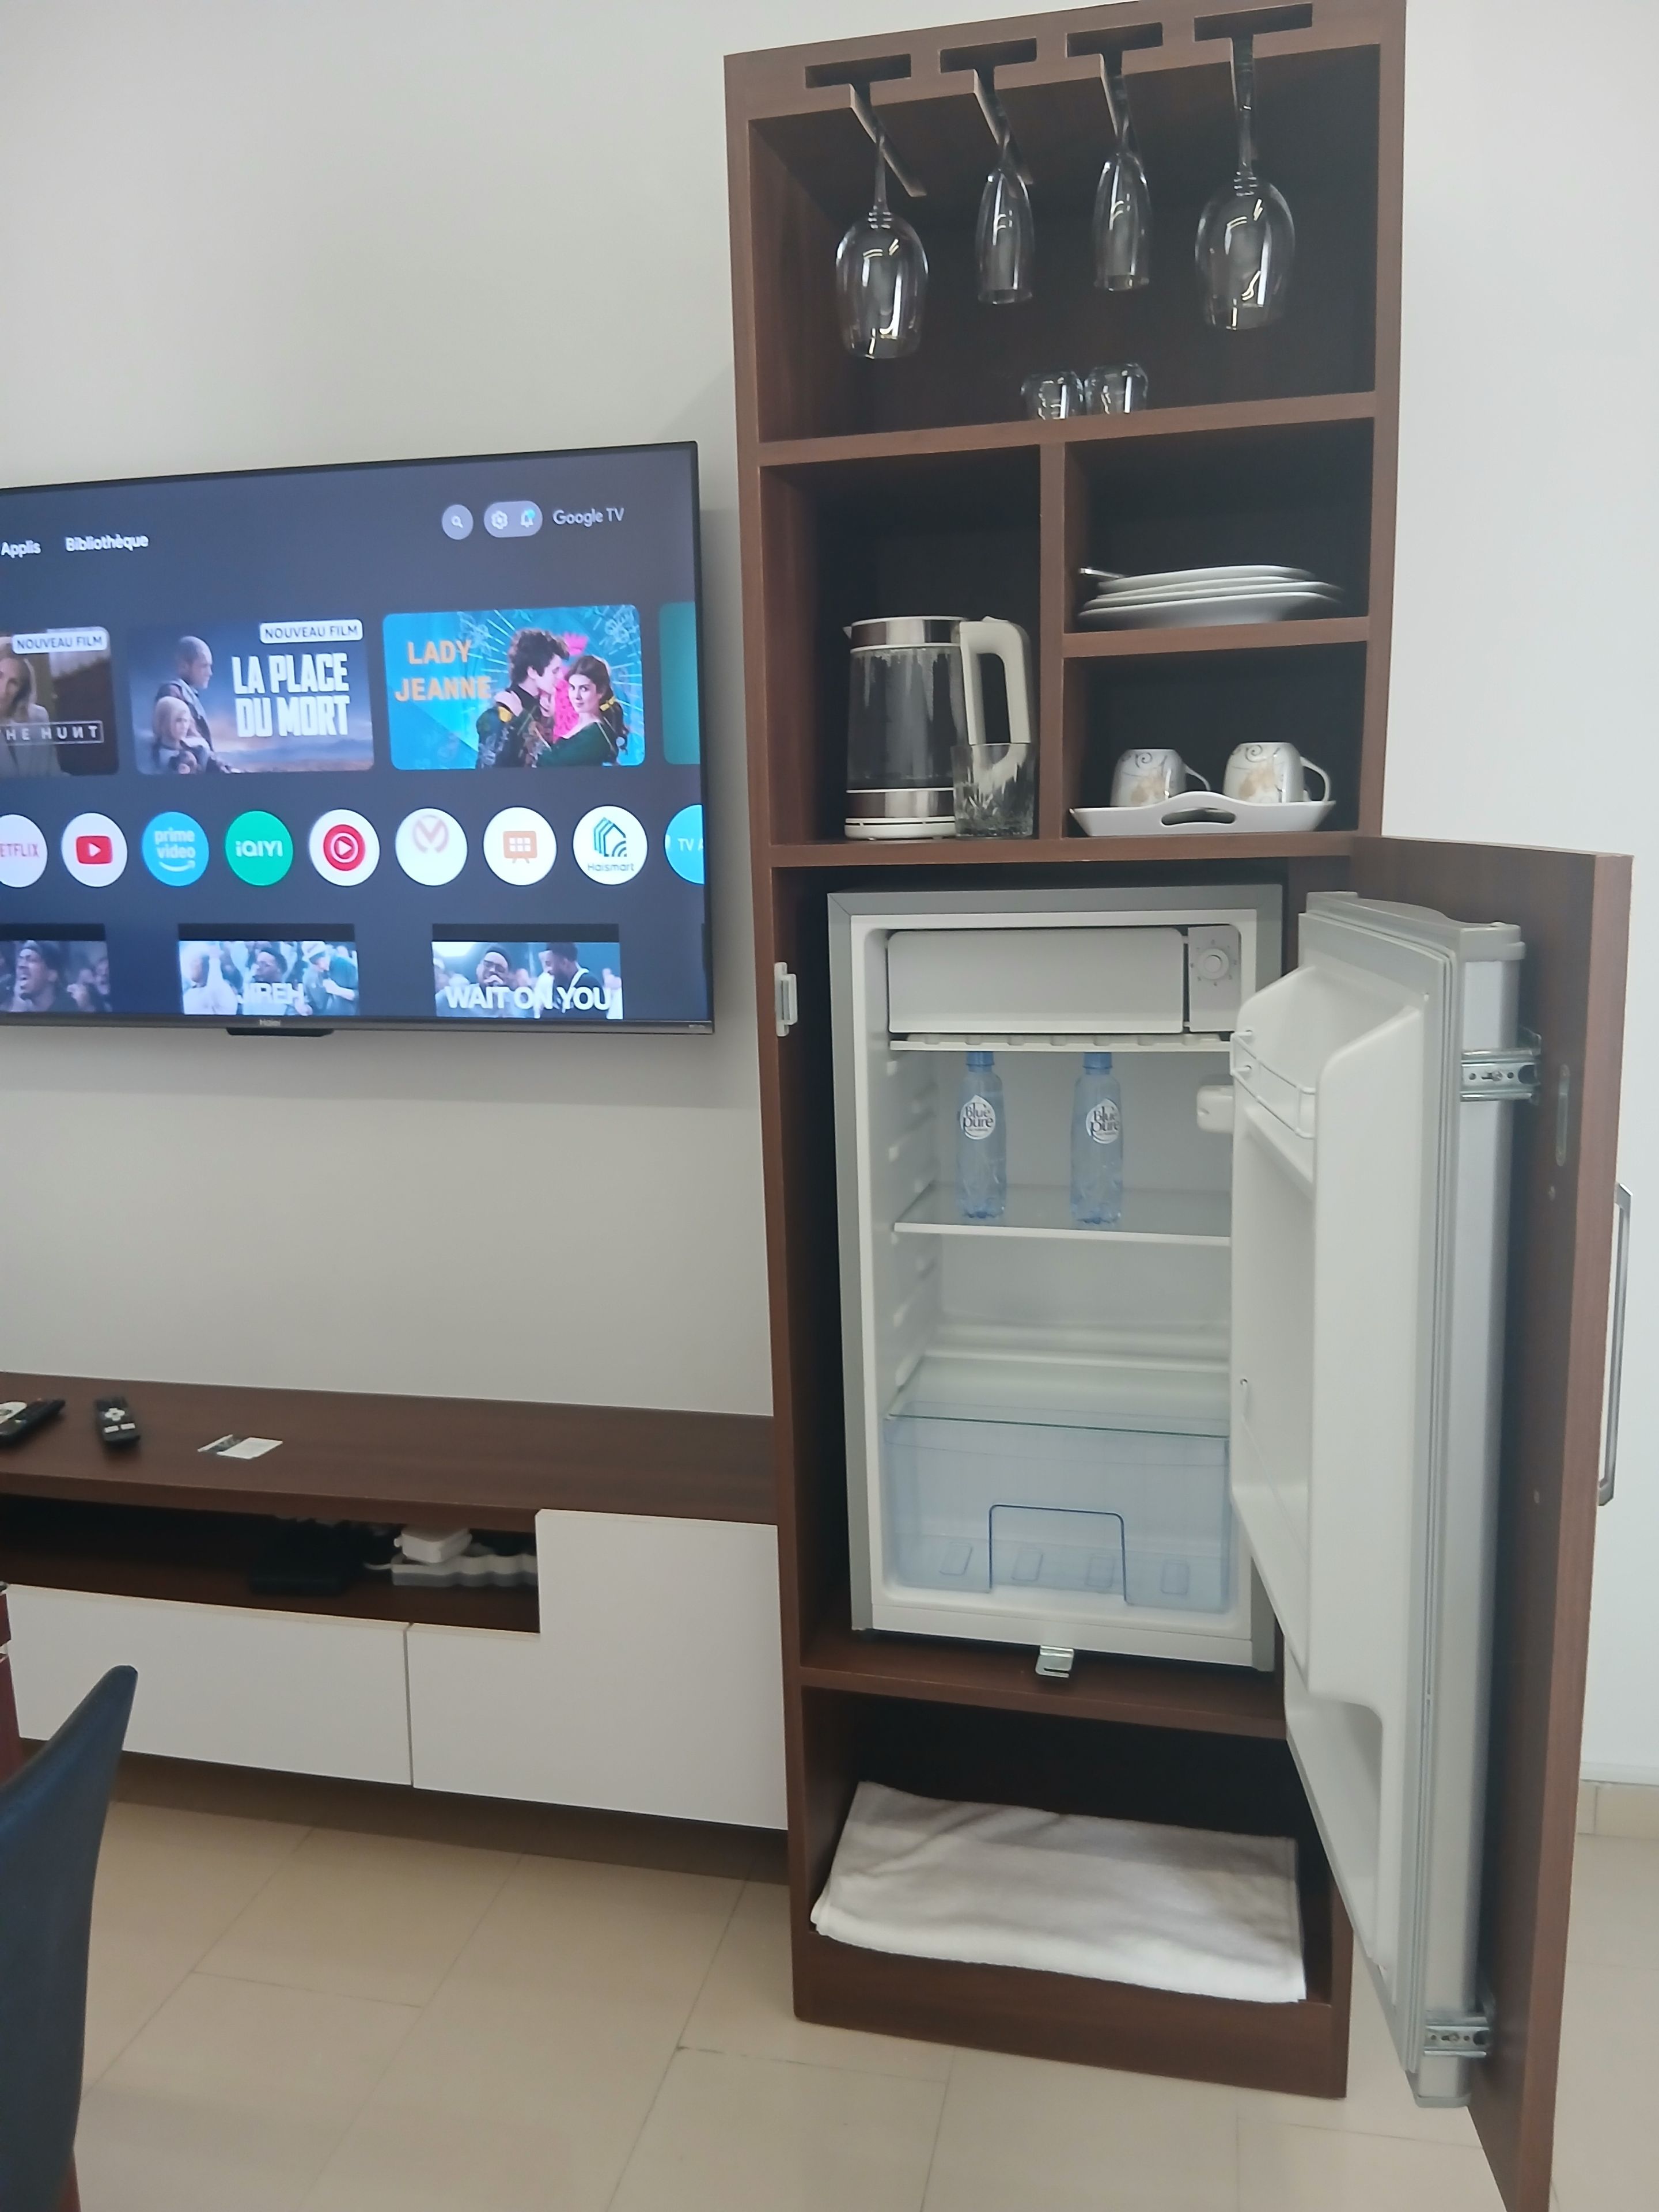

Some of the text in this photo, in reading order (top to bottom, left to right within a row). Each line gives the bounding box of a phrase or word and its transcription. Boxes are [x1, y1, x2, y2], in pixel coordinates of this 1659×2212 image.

[552, 507, 624, 527] Google TV
[1, 540, 41, 558] Applis
[65, 533, 149, 551] Bibliothèque
[264, 625, 358, 639] NOUVEAU FILM
[17, 636, 103, 650] NOUVEAU FILM
[407, 640, 471, 665] LADY
[232, 653, 350, 695] LA PLACE
[395, 676, 492, 702] JEANNE
[236, 696, 350, 738] DU MORT
[0, 728, 31, 741] HE
[154, 828, 195, 844] prime
[677, 838, 694, 851] TV
[157, 846, 196, 858] video
[236, 840, 283, 858] iQIYI
[587, 862, 635, 872] Haismart
[445, 985, 611, 1010] WAIT ON YOU
[965, 1103, 991, 1118] Blue
[963, 1117, 994, 1130] pure
